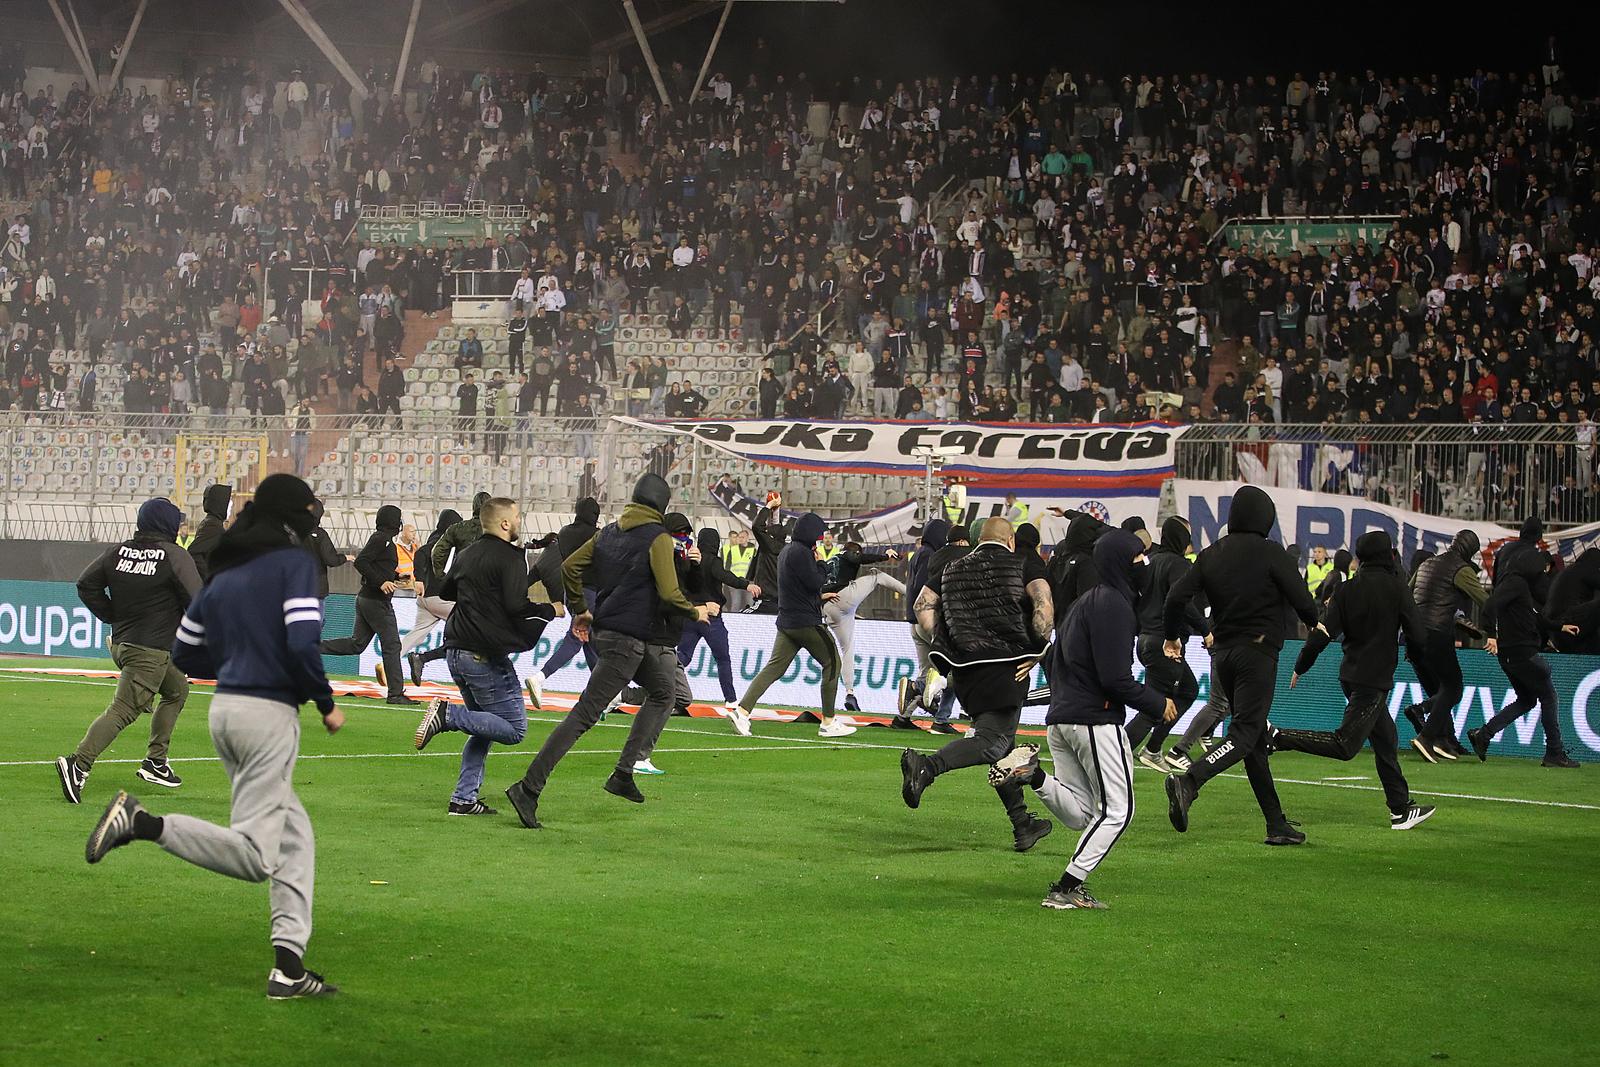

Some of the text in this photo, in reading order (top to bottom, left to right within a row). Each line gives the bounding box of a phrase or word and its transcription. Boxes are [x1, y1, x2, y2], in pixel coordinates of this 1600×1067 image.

[370, 232, 408, 243] EXIT
[118, 545, 166, 561] macron
[115, 558, 158, 576] HAJDUK
[0, 602, 105, 656] oupa
